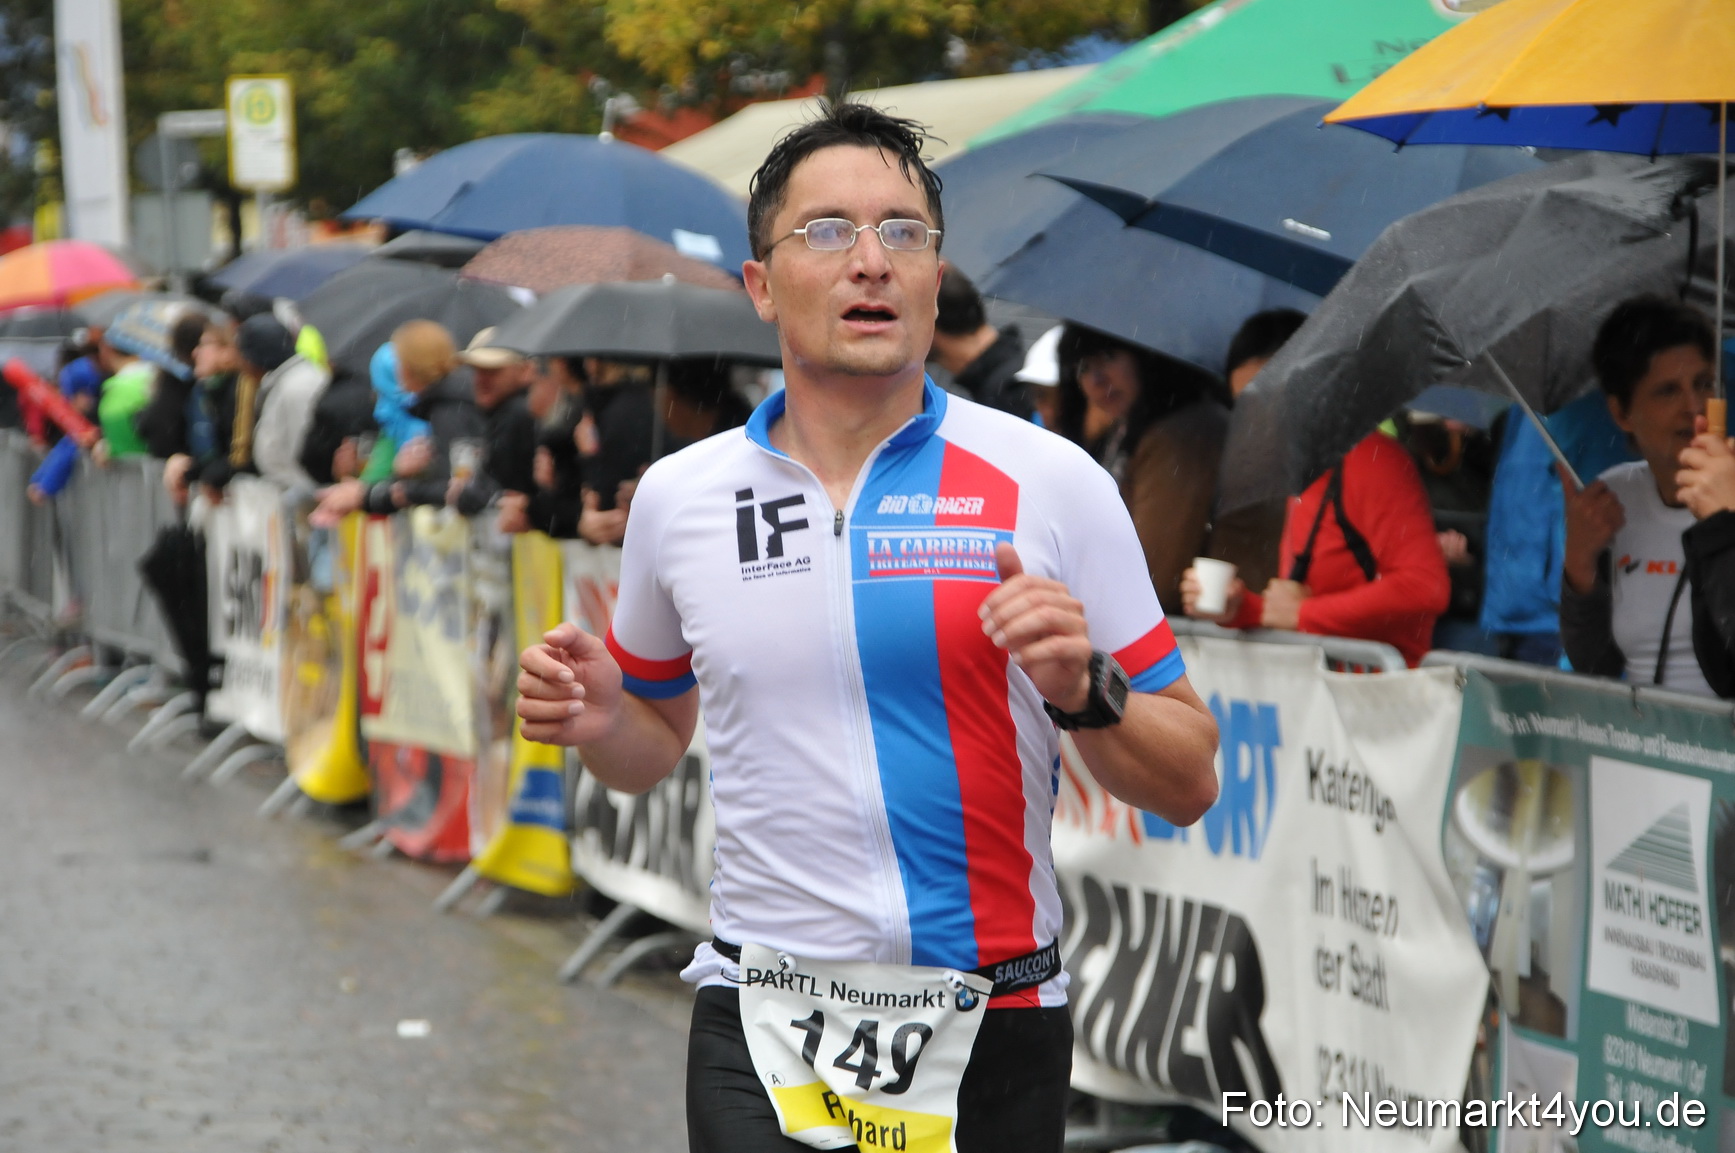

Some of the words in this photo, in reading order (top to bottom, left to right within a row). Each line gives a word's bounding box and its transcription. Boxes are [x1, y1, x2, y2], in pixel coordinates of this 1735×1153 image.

[932, 496, 985, 516] RACER
[868, 538, 892, 557] LA
[900, 538, 996, 558] CARRERA
[741, 561, 792, 575] InterFace
[795, 556, 811, 567] AG
[869, 557, 929, 570] TRITEAM
[1604, 879, 1645, 921] MATHI
[1648, 892, 1704, 938] HOFFER
[995, 945, 1056, 983] SAUCONY
[746, 968, 823, 997] PARTL
[830, 980, 946, 1008] Neumarkt
[790, 1010, 933, 1095] 149
[771, 1073, 782, 1085] A
[822, 1090, 907, 1151] Rhard
